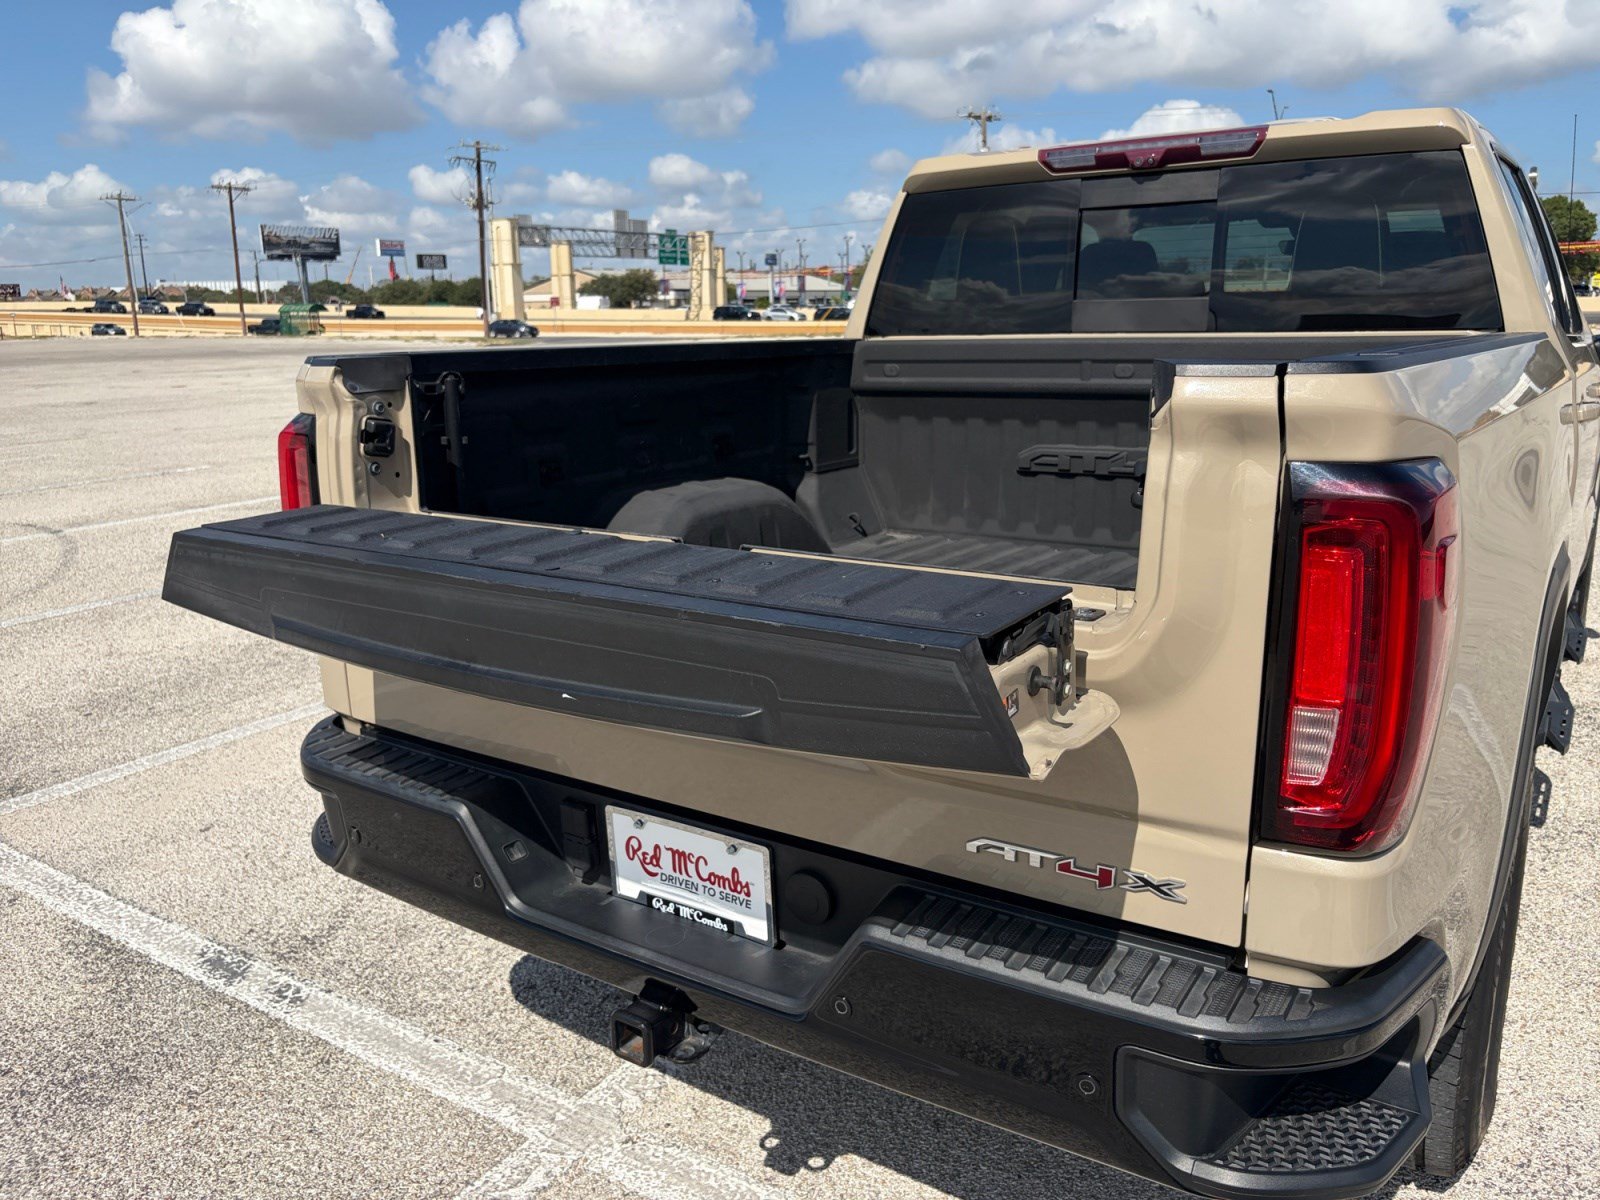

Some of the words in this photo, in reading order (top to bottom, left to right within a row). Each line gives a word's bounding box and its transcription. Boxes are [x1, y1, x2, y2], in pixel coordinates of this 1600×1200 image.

[625, 835, 663, 877] Red
[664, 846, 751, 897] McCombs
[660, 872, 699, 892] DRIVEN
[702, 884, 717, 897] TO
[719, 890, 752, 909] SERVE
[652, 897, 675, 915] Red
[676, 904, 728, 932] McCombs
